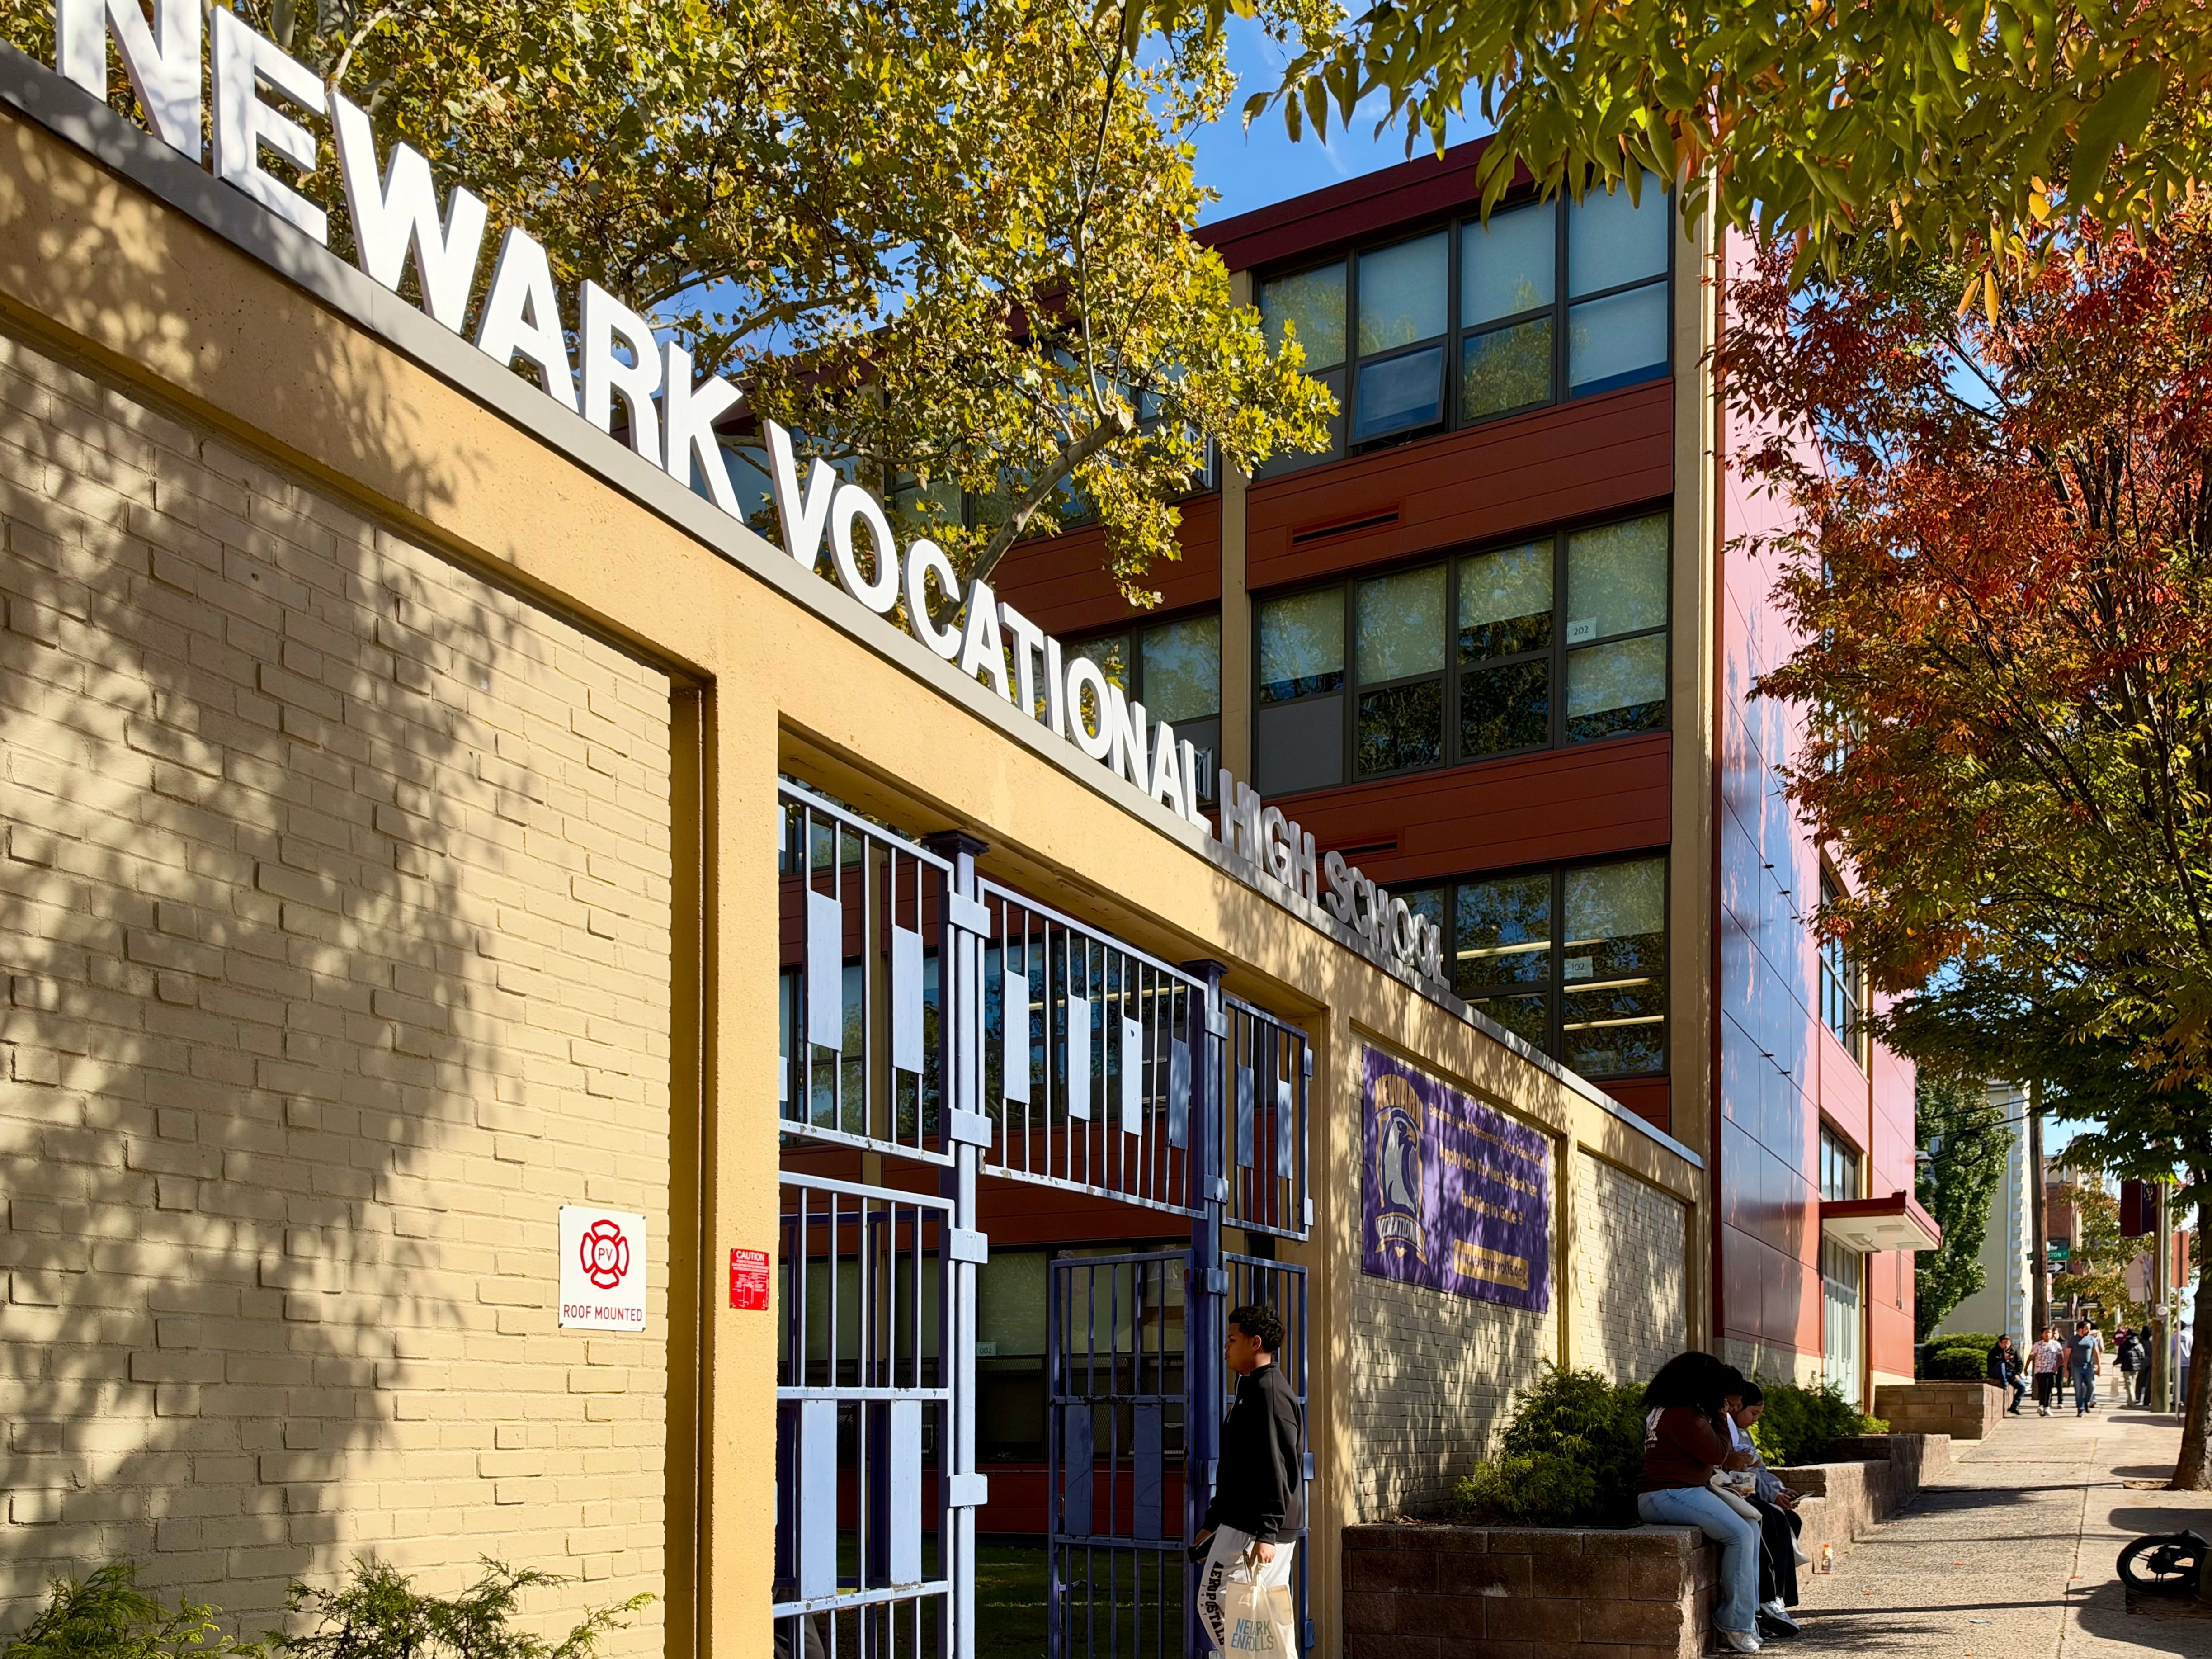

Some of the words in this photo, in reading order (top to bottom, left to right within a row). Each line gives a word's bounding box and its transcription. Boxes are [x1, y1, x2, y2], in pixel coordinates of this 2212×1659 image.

[56, 0, 744, 523] NEWARK
[763, 419, 1212, 837] VOCATIONAL
[1220, 768, 1318, 906] HIGH
[1324, 850, 1450, 992] SCHOOL
[1574, 625, 1589, 635] 202
[1375, 1074, 1423, 1134] NEWARK
[1429, 1102, 1451, 1124] Become
[1489, 1163, 1504, 1185] Next
[1519, 1211, 1523, 1226] 9
[1378, 1216, 1422, 1250] VOCATIONAL
[599, 1248, 613, 1262] PV
[736, 1250, 764, 1262] CAUTION
[564, 1304, 591, 1319] ROOF
[595, 1306, 642, 1322] MOUNTED
